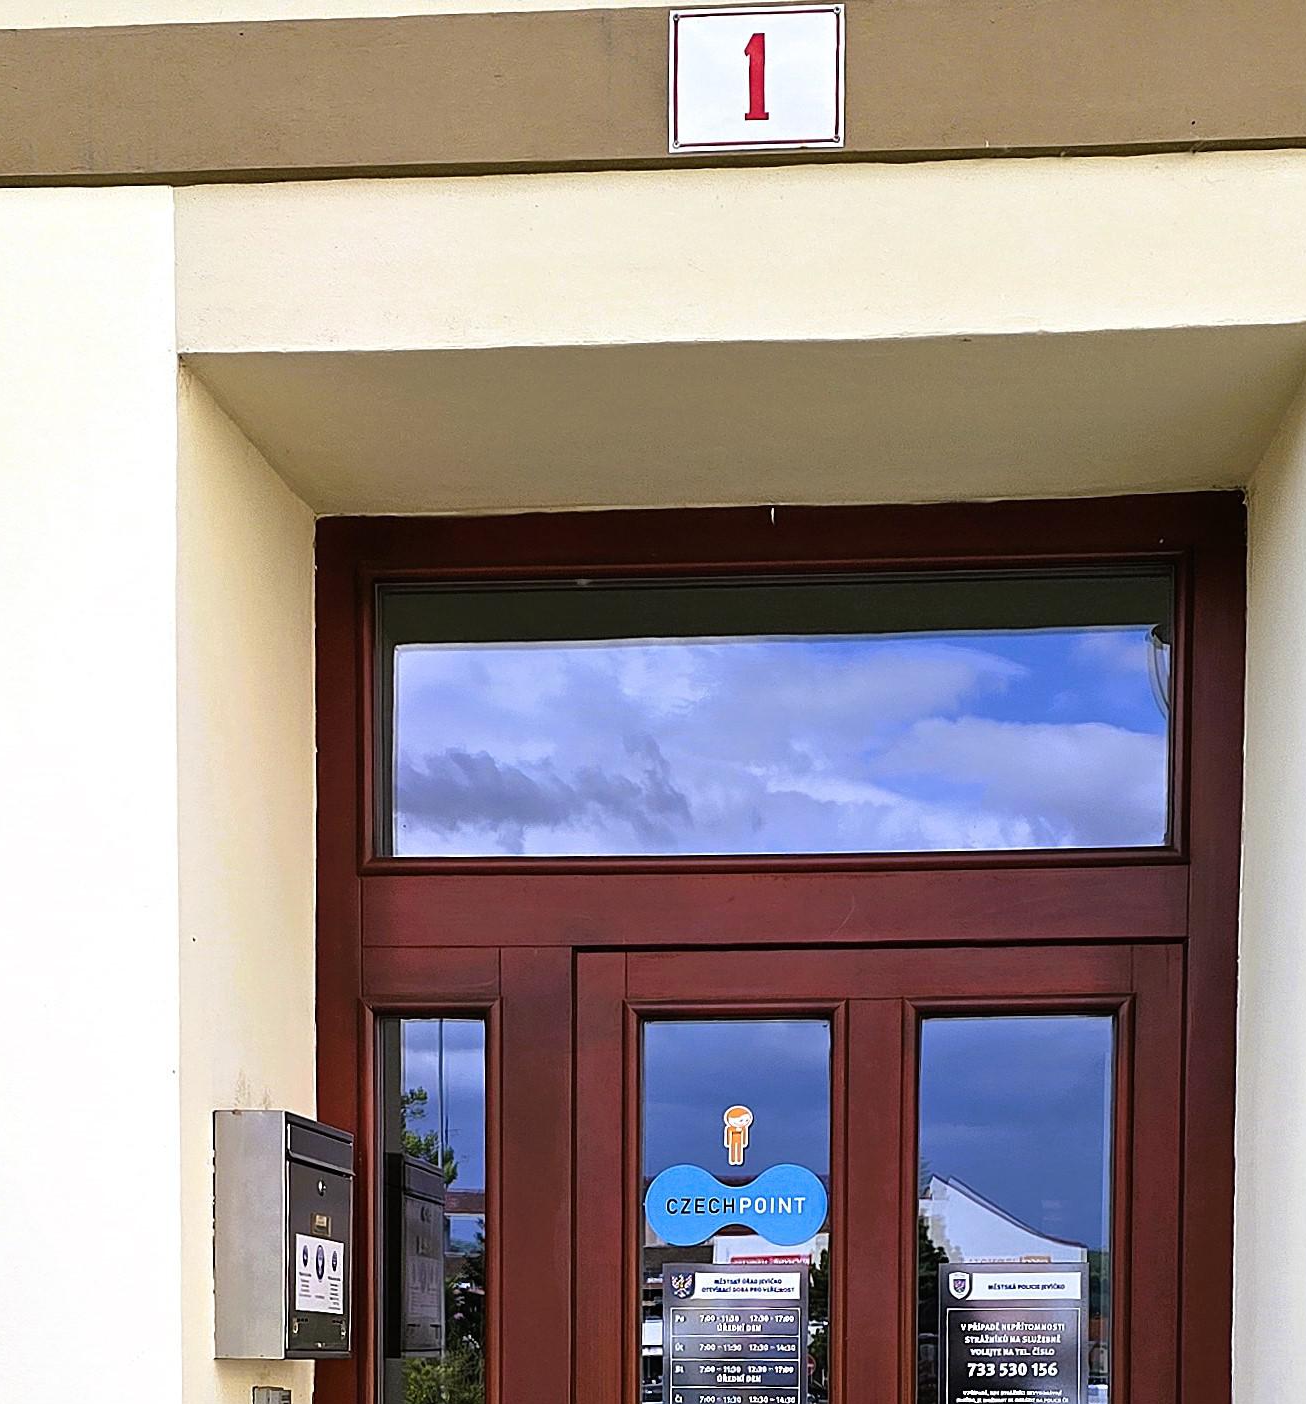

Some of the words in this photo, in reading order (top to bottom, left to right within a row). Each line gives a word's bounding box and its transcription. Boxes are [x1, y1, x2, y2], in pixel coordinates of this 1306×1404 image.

[744, 32, 769, 121] 1
[960, 1323, 967, 1331] V
[967, 1322, 1000, 1331] PŘÍPADĚ
[1001, 1322, 1065, 1331] NEPŘÍTOMNOSTI
[1003, 1348, 1014, 1356] NA
[1032, 1346, 1055, 1356] ČÍSLO
[967, 1363, 996, 1377] 733
[999, 1363, 1028, 1377] 530
[1031, 1362, 1058, 1377] 156
